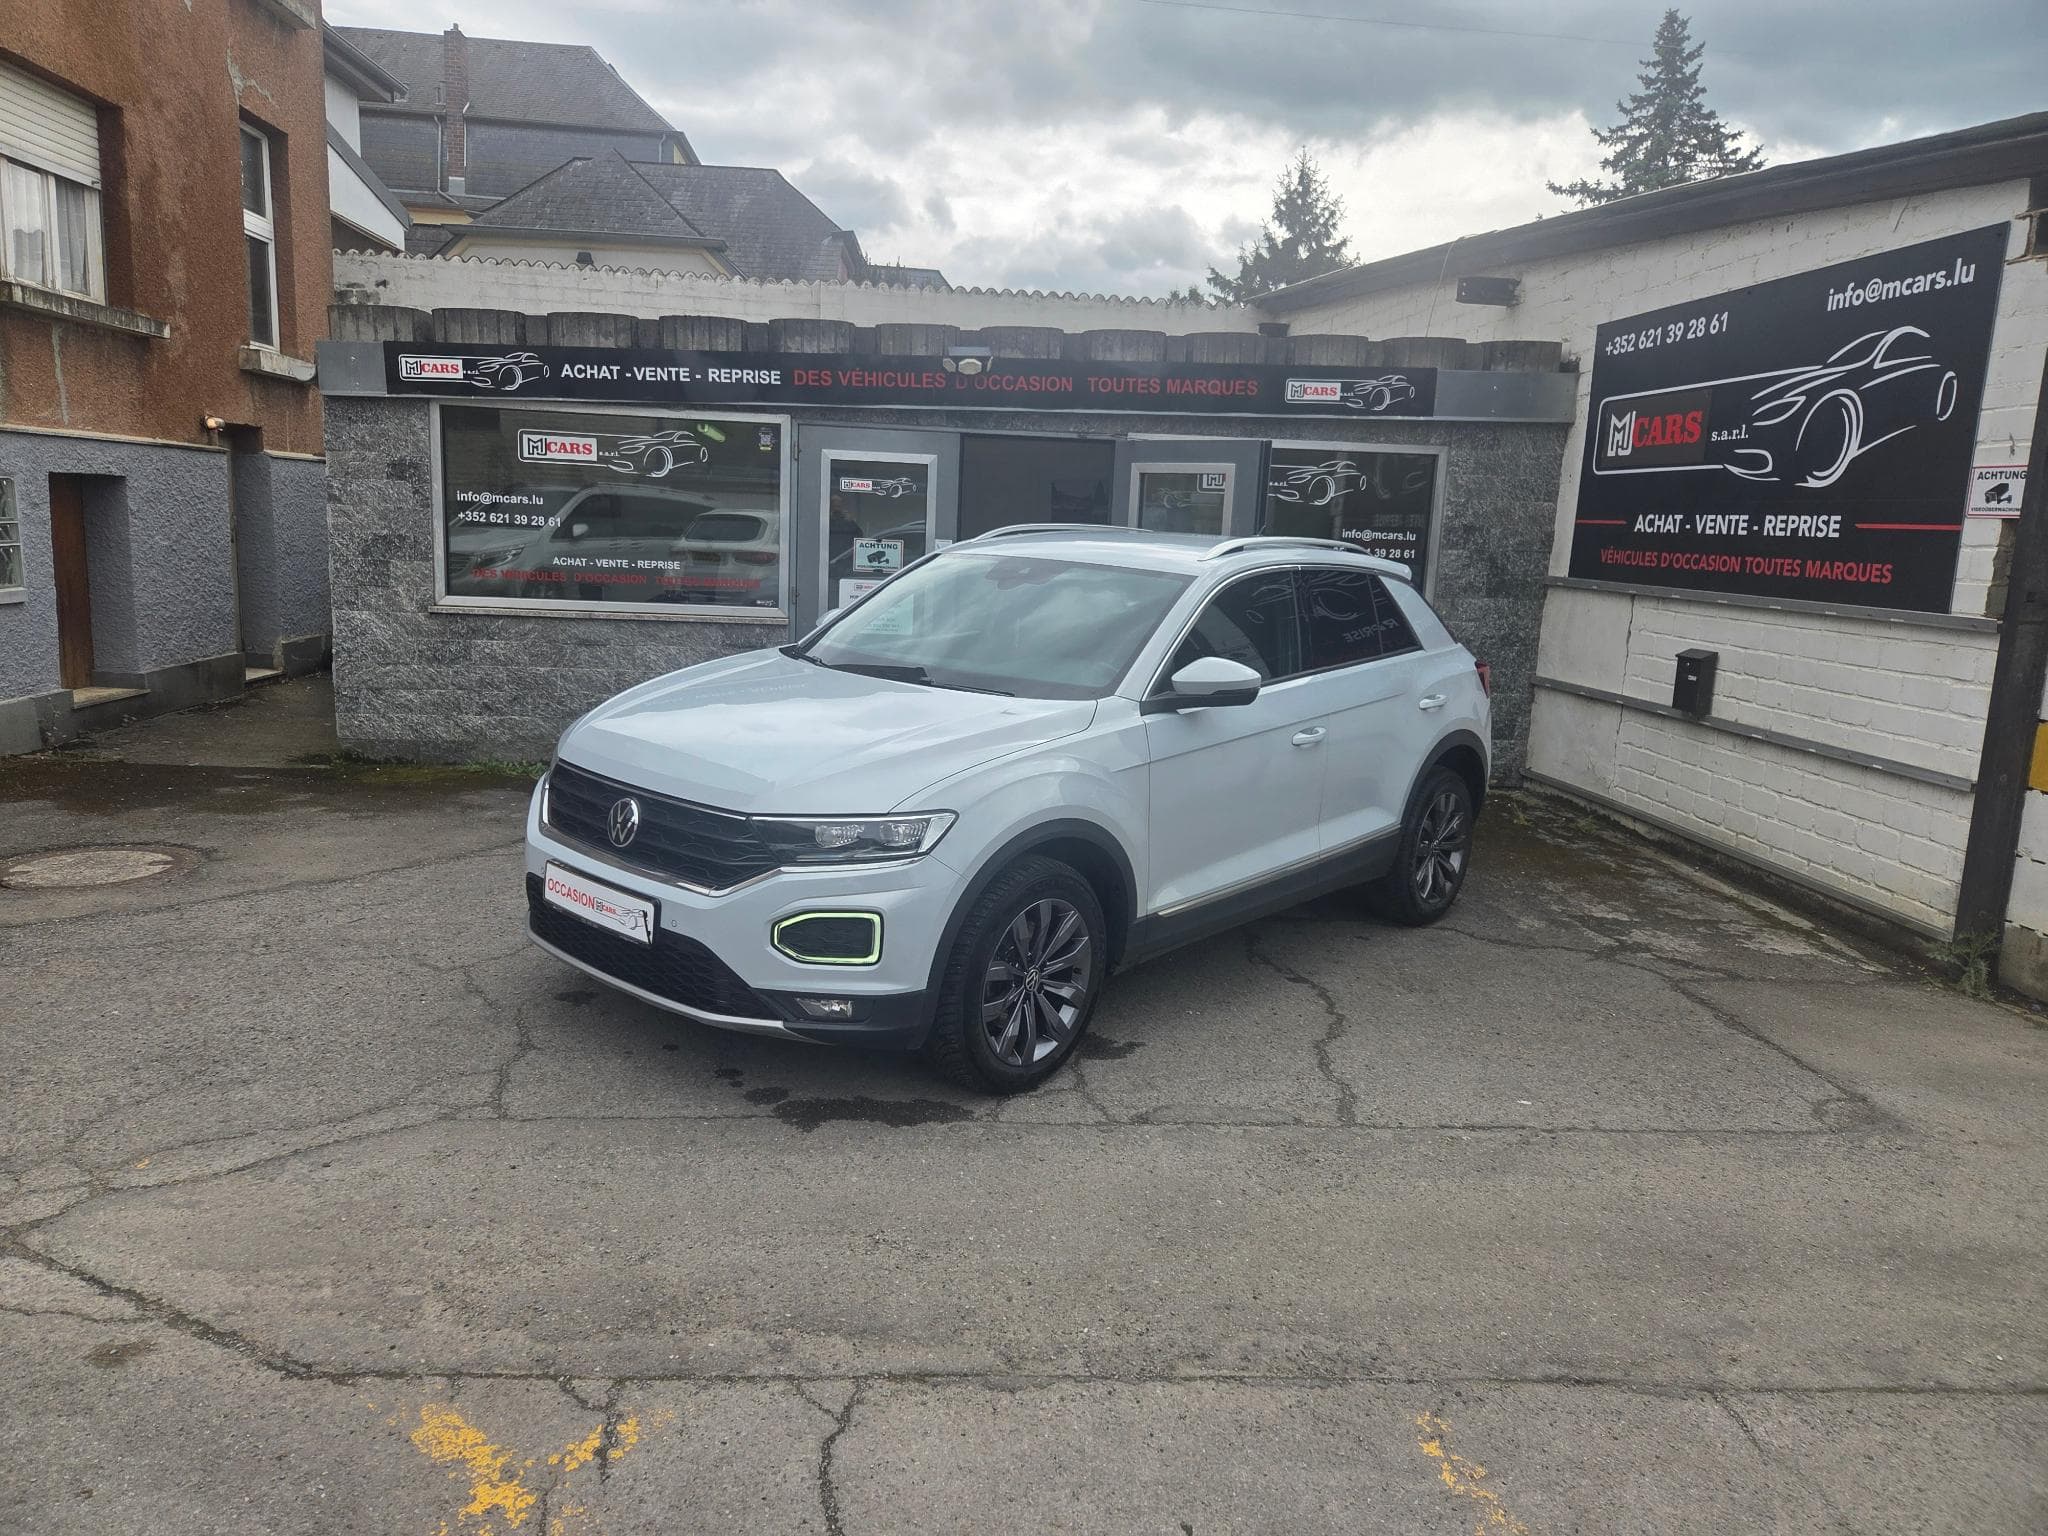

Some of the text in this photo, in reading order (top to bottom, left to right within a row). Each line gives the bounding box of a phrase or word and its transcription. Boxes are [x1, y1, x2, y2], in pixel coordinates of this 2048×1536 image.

[1827, 258, 1976, 312] info@mcars.lu
[1605, 311, 1729, 356] +352 621 39 28 61
[561, 364, 620, 380] ACHAT
[708, 368, 781, 385] REPRISE
[793, 369, 832, 386] DES
[838, 368, 947, 388] VÉHICULES
[955, 373, 1073, 392] DOCCASION
[1088, 376, 1161, 394] TOUTES
[1167, 378, 1259, 396] MARQUES
[1711, 424, 1749, 441] s.a.r.l.
[1977, 470, 2028, 480] ACHTUNG
[456, 490, 544, 505] info@mcars.lu
[458, 511, 561, 527] +352 621 39 28 61
[1634, 514, 1683, 534] ACHAT
[1696, 515, 1749, 536] VENTE
[1763, 515, 1841, 538] REPRISE
[1342, 529, 1416, 541] info@mcars.lu
[859, 542, 898, 550] ACHTUNG
[1374, 548, 1386, 558] 39
[1389, 549, 1401, 558] 28
[1403, 549, 1415, 559] 61
[552, 556, 586, 567] ACHAT
[596, 559, 628, 569] VENTE
[637, 560, 681, 570] REPRISE
[1600, 546, 1658, 567] VÉHICULES
[1745, 556, 1801, 577] TOUTES
[1805, 560, 1893, 584] MARQUES
[547, 878, 595, 910] OCCASION
